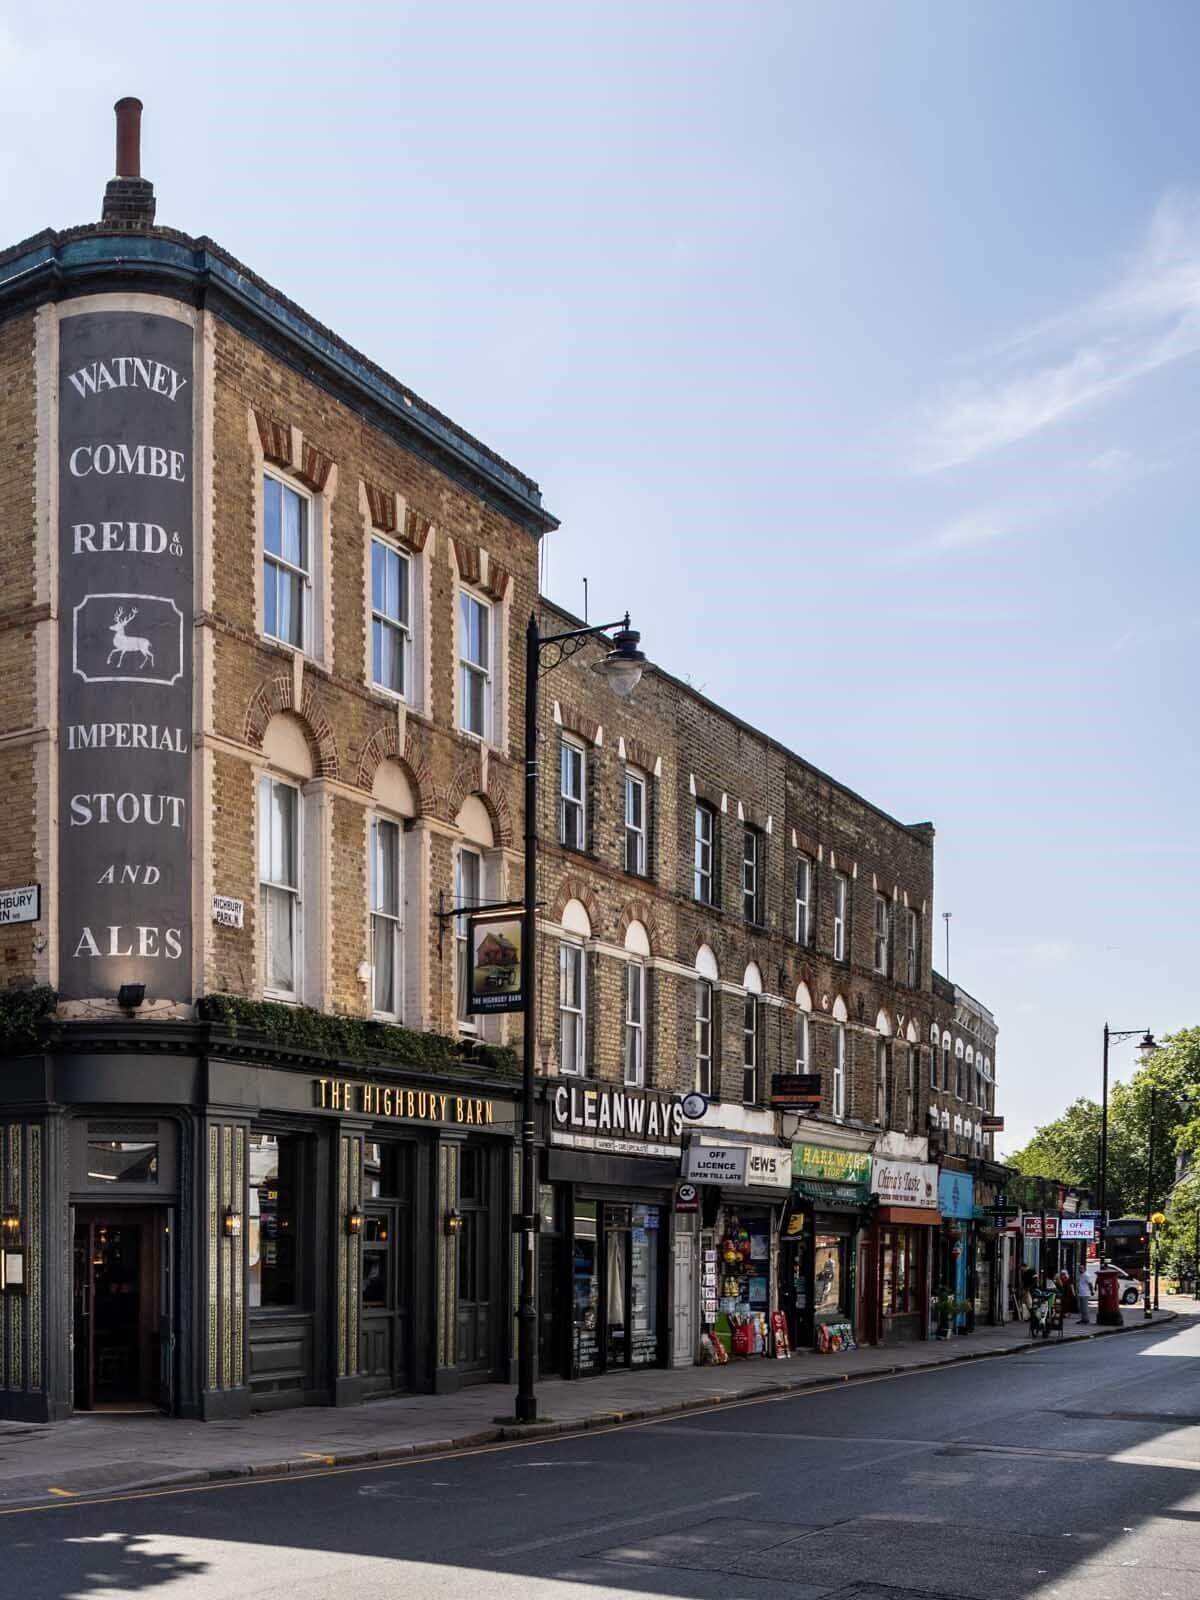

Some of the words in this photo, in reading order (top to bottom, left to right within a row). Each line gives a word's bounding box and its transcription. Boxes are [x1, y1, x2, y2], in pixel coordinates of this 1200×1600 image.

[67, 357, 188, 401] WATNEY
[69, 444, 186, 482] COMBE
[72, 521, 168, 555] REID
[67, 723, 188, 754] IMPERIAL
[70, 792, 185, 828] STOUT
[98, 865, 161, 885] AND
[213, 897, 242, 912] HIGHBURY
[72, 926, 183, 959] ALES
[319, 1079, 352, 1111] THE
[363, 1084, 448, 1121] HIGHBURY
[456, 1096, 495, 1125] BARN
[555, 1086, 683, 1137] CLEANWAYS
[698, 1162, 736, 1170] LICENCE
[709, 1151, 726, 1159] OFF
[750, 1156, 777, 1173] NEWS
[878, 1167, 902, 1190] China's
[904, 1172, 920, 1192] Taste
